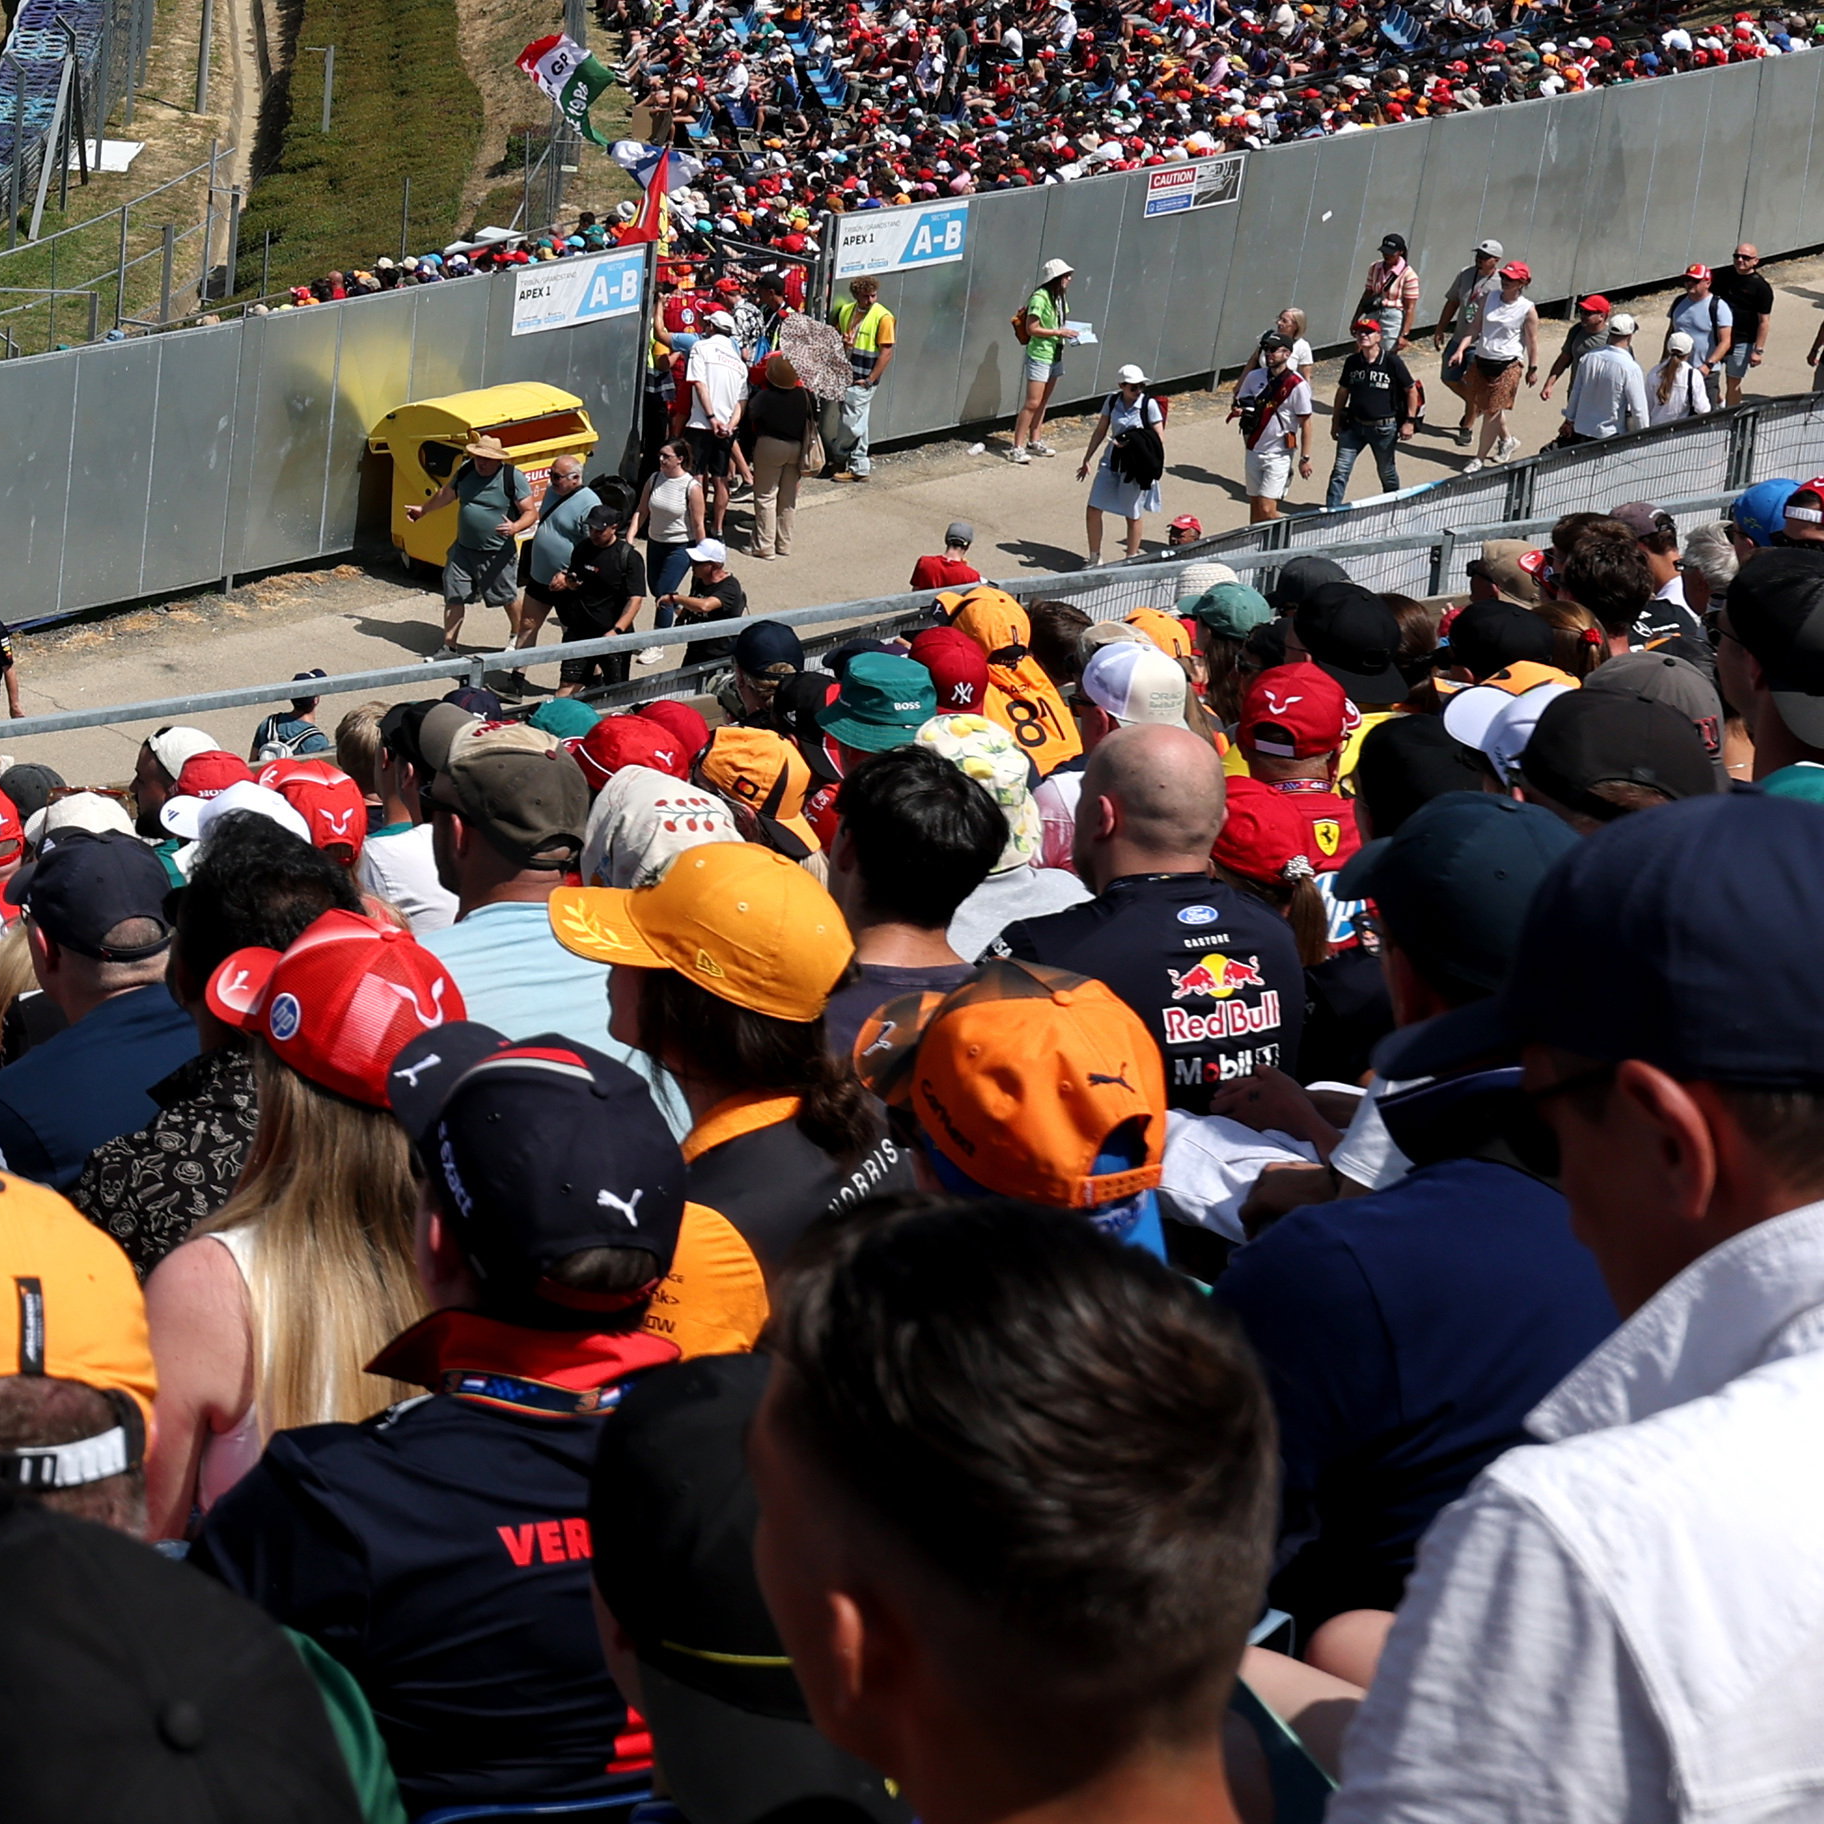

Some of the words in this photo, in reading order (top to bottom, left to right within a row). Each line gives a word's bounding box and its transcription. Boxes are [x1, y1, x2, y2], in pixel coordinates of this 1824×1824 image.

[551, 53, 568, 75] GP
[1154, 171, 1193, 187] CAUTION
[842, 235, 866, 247] APEX
[869, 234, 874, 244] 1
[913, 220, 962, 255] A-B
[518, 287, 543, 301] APEX
[545, 286, 551, 296] 1
[588, 269, 638, 308] A-B
[894, 701, 921, 711] BOSS
[1005, 697, 1066, 747] 81
[1184, 933, 1230, 948] CASTORE
[272, 1000, 298, 1036] hp
[1162, 1001, 1227, 1044] Red
[1228, 990, 1281, 1036] Bull
[1174, 1050, 1252, 1085] Mobil
